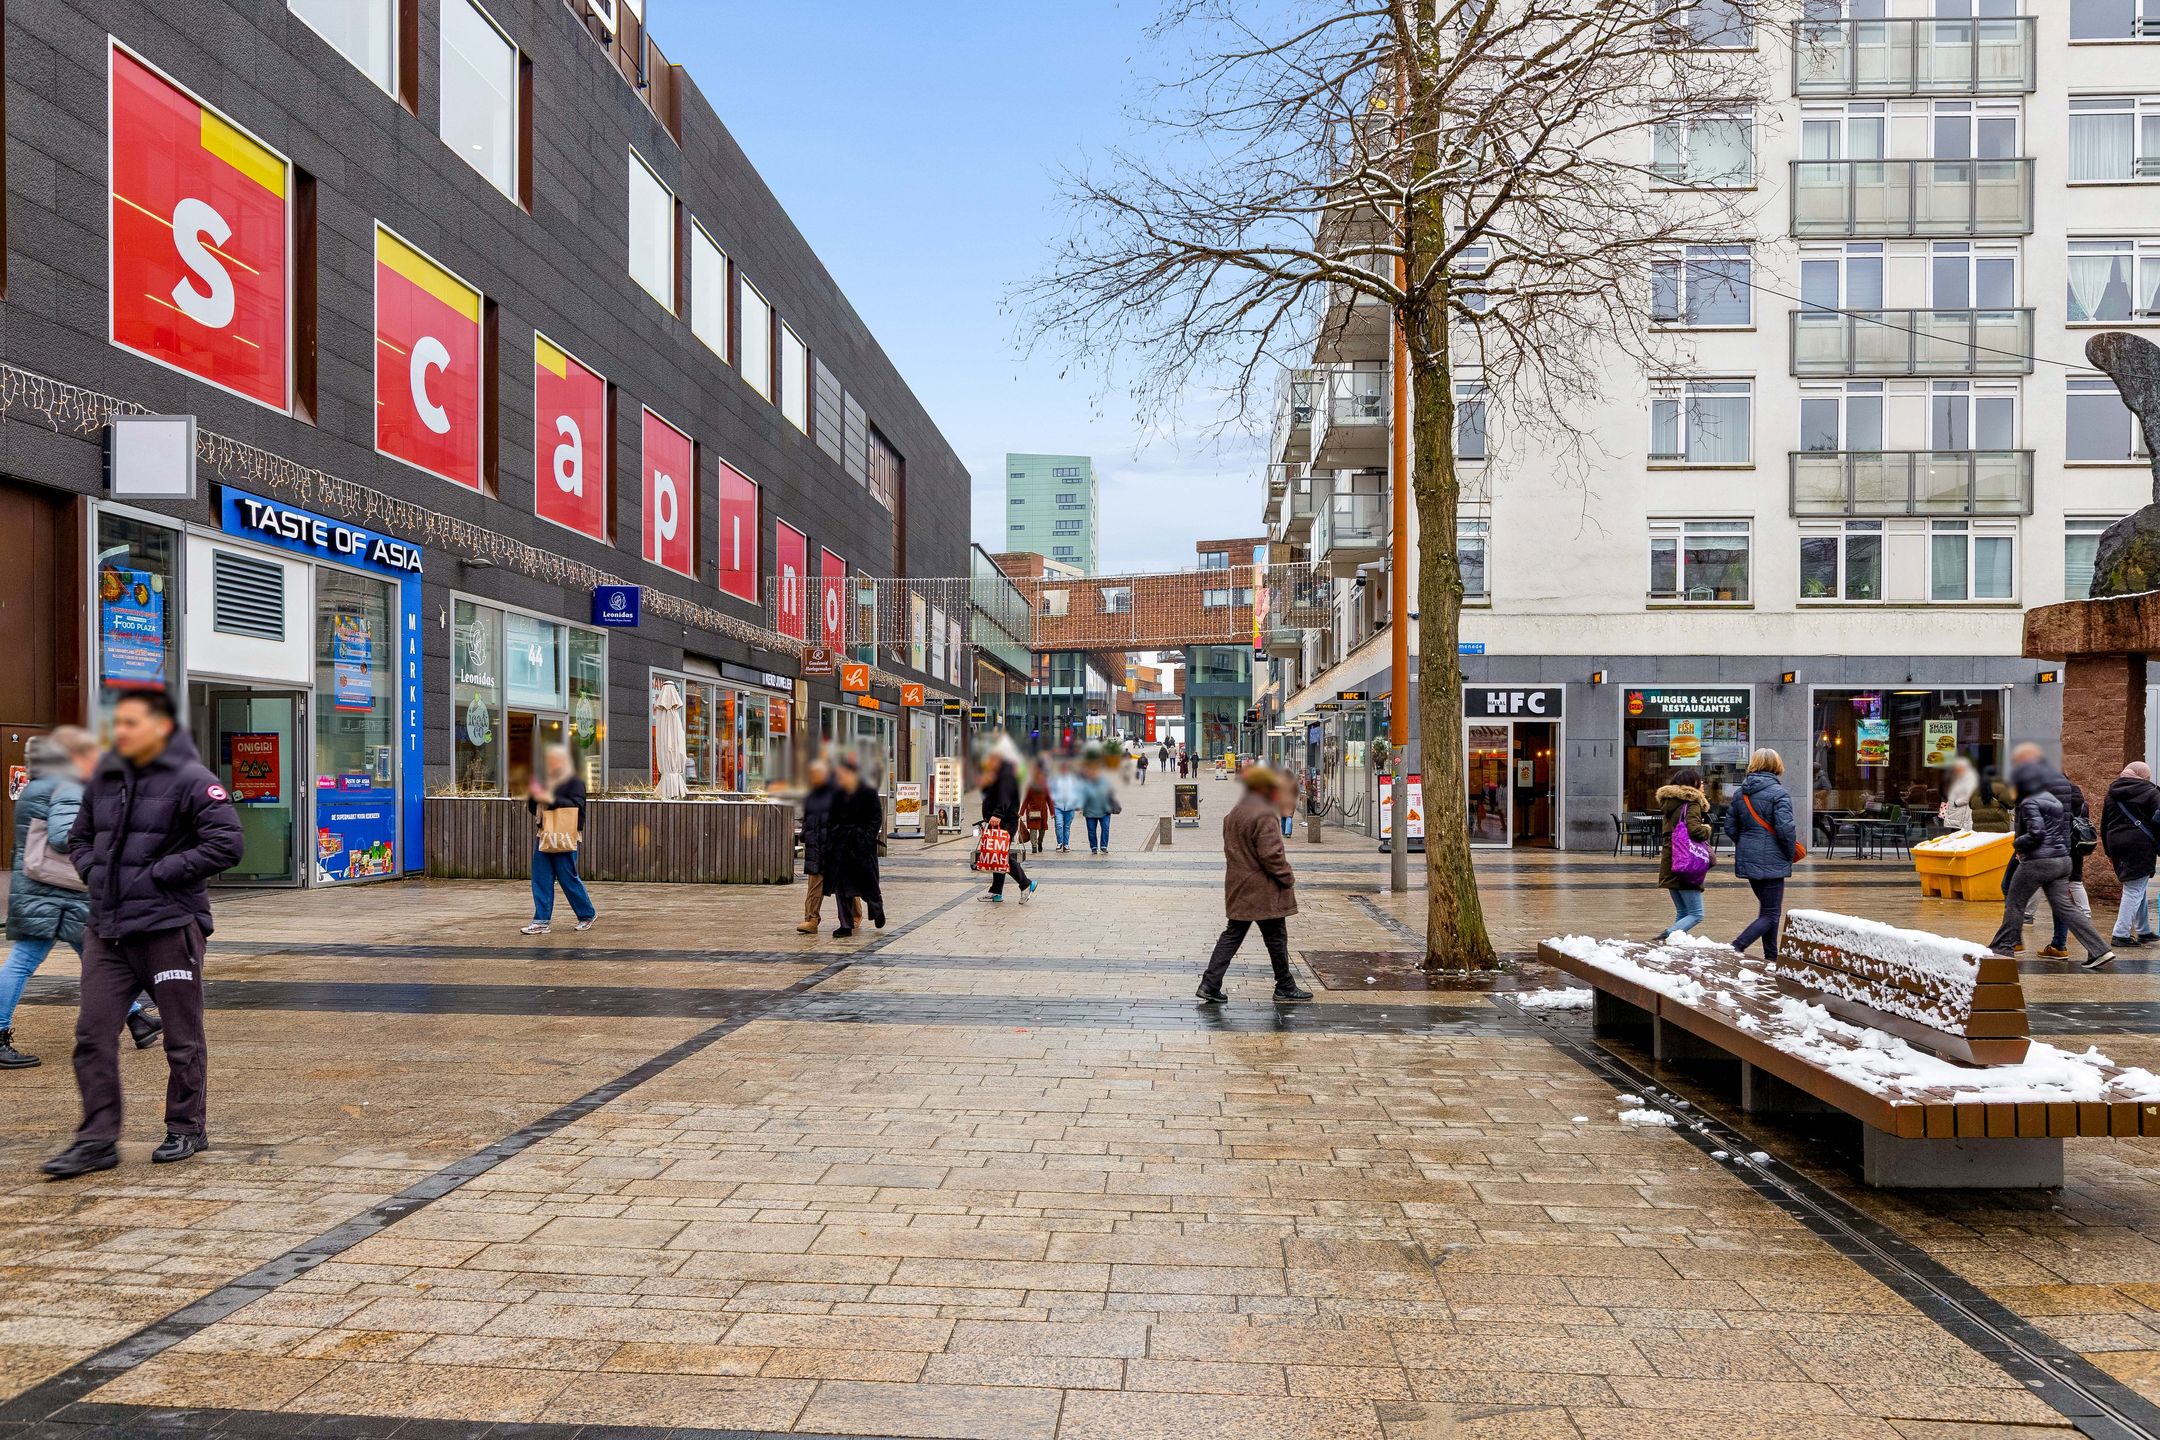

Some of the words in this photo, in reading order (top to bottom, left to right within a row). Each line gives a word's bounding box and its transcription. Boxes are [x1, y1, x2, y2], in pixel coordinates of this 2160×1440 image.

[245, 498, 328, 547] TASTE
[336, 529, 367, 554] OF
[372, 540, 424, 573] ASIA
[113, 615, 135, 629] FOOD
[136, 623, 156, 632] PLAZA
[528, 643, 543, 667] 44
[408, 613, 417, 750] MARKET
[461, 668, 495, 687] Leonidas
[2042, 673, 2053, 682] HFC
[1486, 692, 1546, 714] HFC
[1650, 695, 1688, 704] BURGER
[1690, 695, 1698, 704] &
[1701, 695, 1743, 704] CHICKEN
[1662, 704, 1731, 713] RESTAURANTS
[1678, 723, 1695, 732] FISH
[237, 742, 272, 752] ONIGIRI
[539, 832, 574, 851] ZARA
